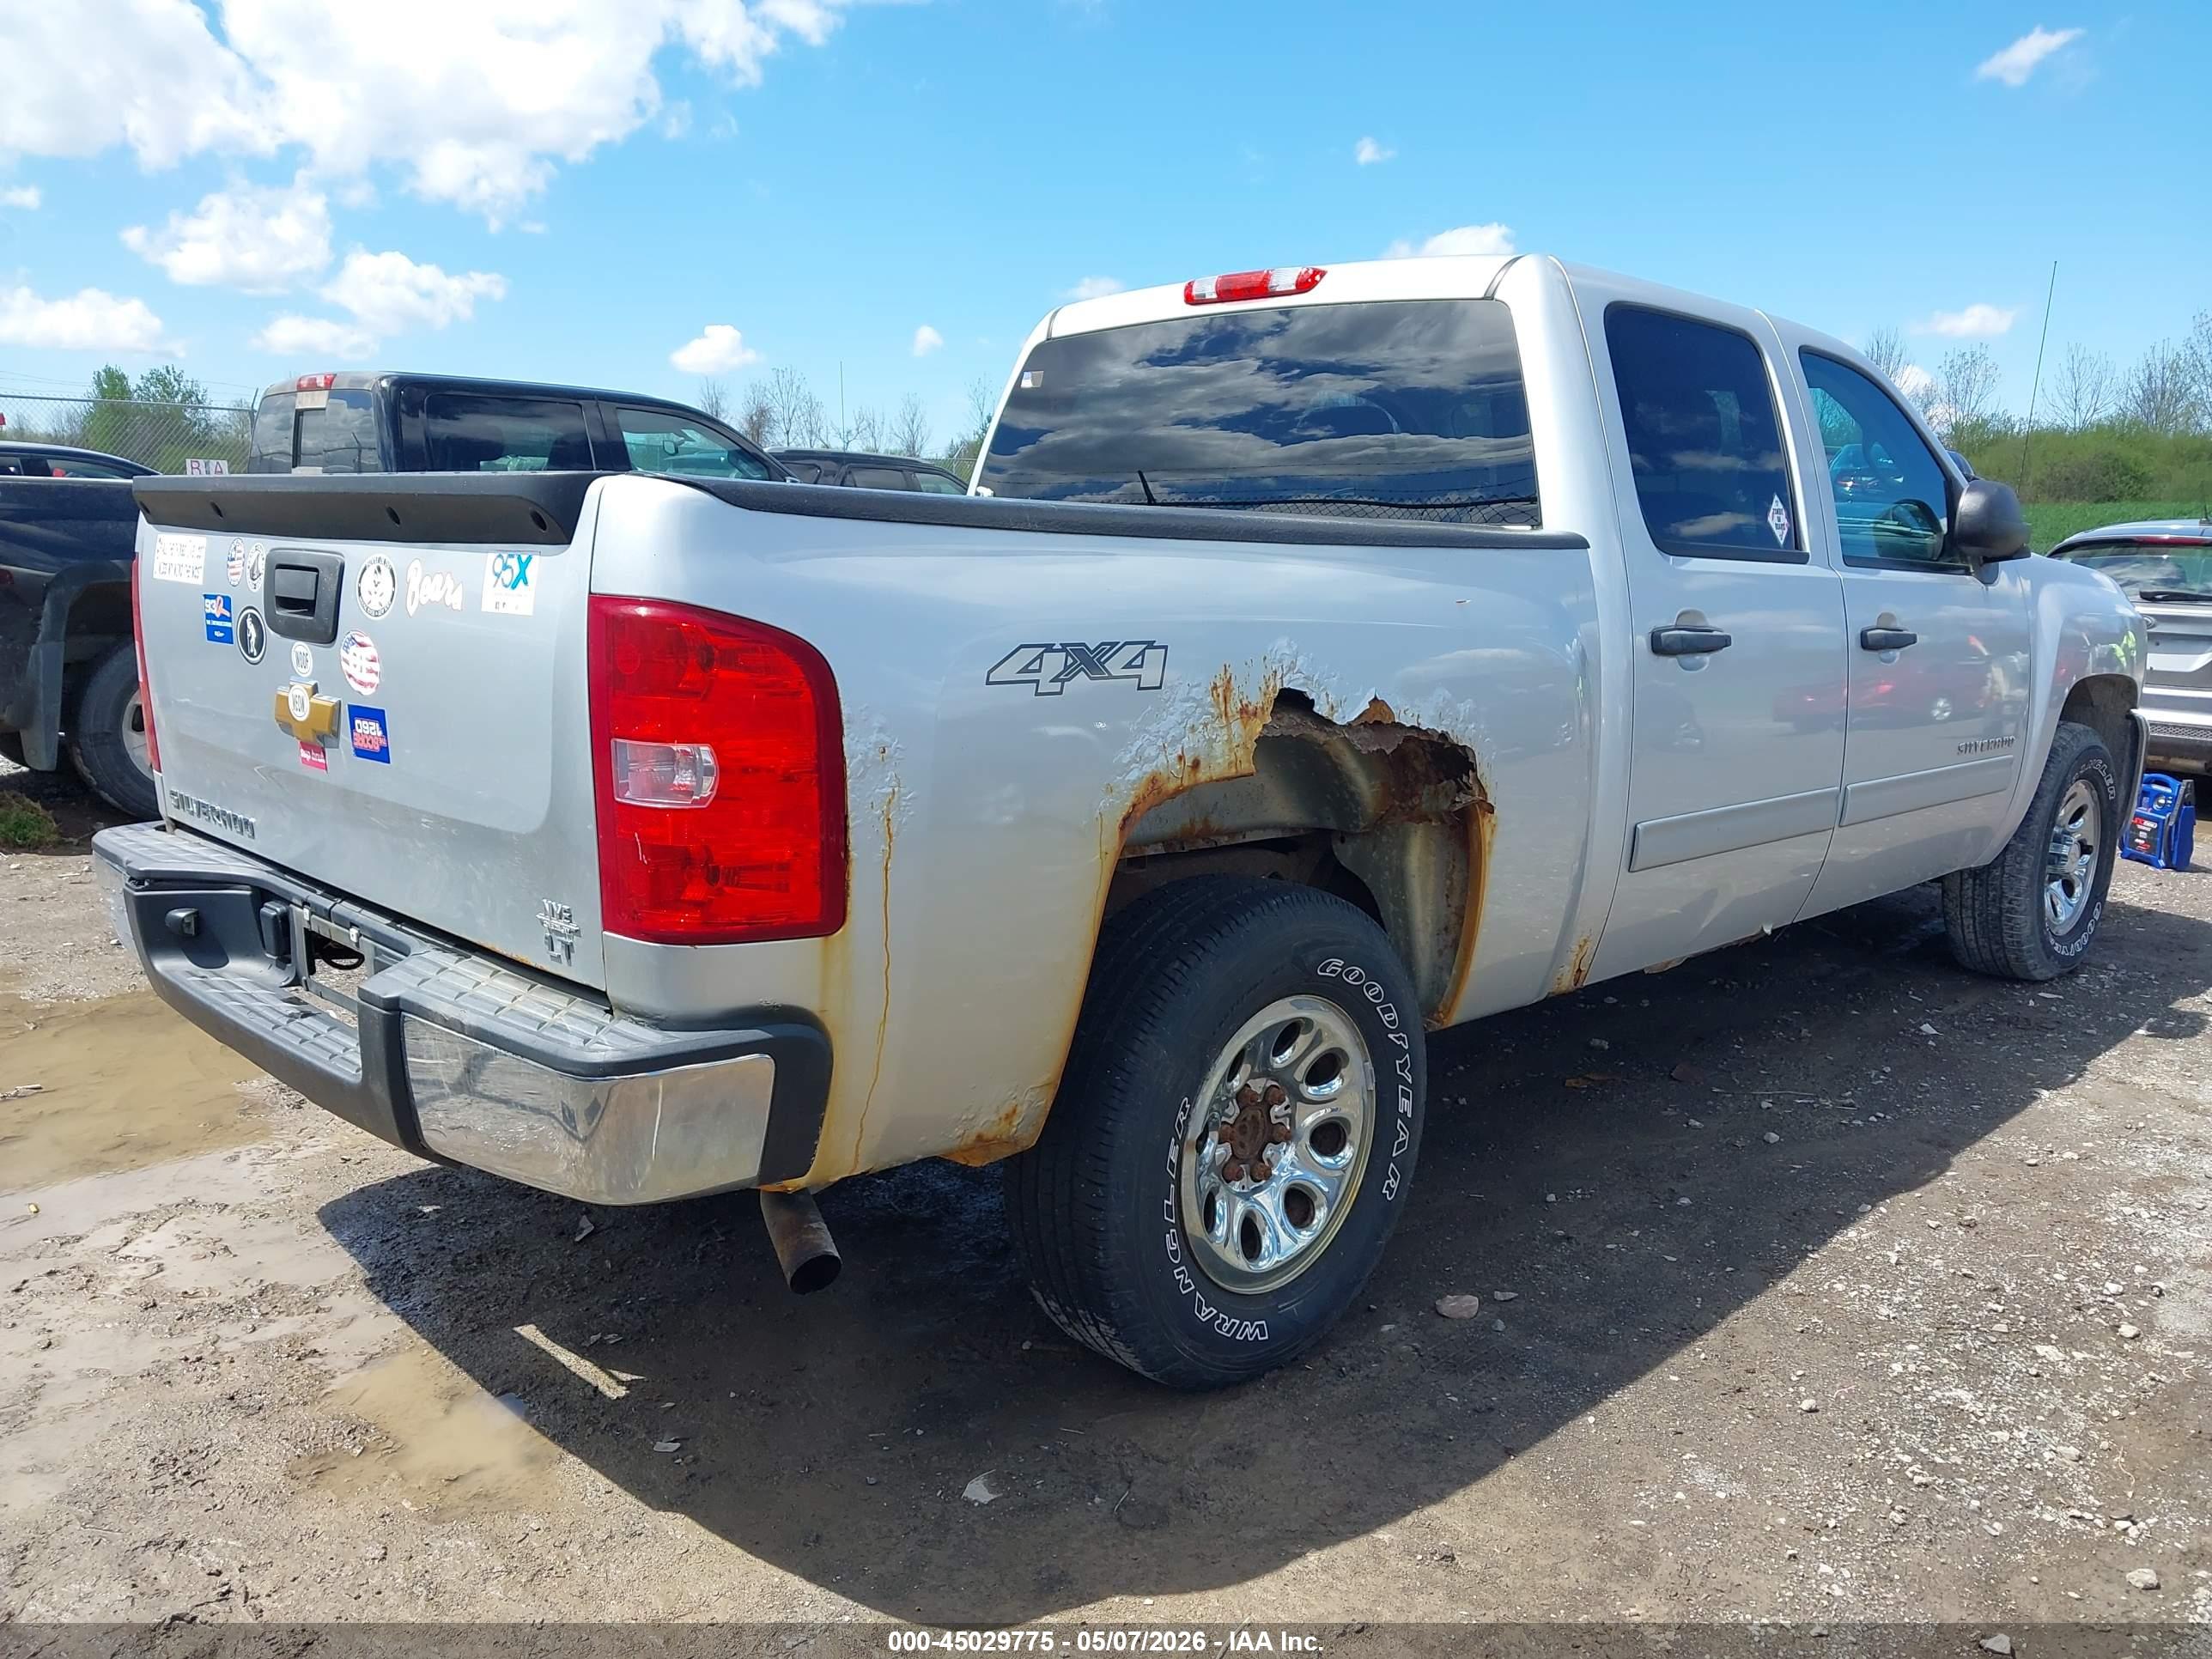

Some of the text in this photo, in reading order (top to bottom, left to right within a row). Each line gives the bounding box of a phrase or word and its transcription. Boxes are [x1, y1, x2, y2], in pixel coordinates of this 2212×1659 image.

[406, 557, 463, 617] Bears
[492, 553, 532, 590] 95X
[295, 649, 309, 669] WOOF
[355, 719, 383, 737] 1260
[1957, 735, 2015, 755] SILVERADO
[169, 788, 255, 840] SILVERADO
[544, 933, 574, 967] LT
[1317, 957, 1413, 1201] GOODYEAR
[1164, 1097, 1269, 1341] WRANGLER
